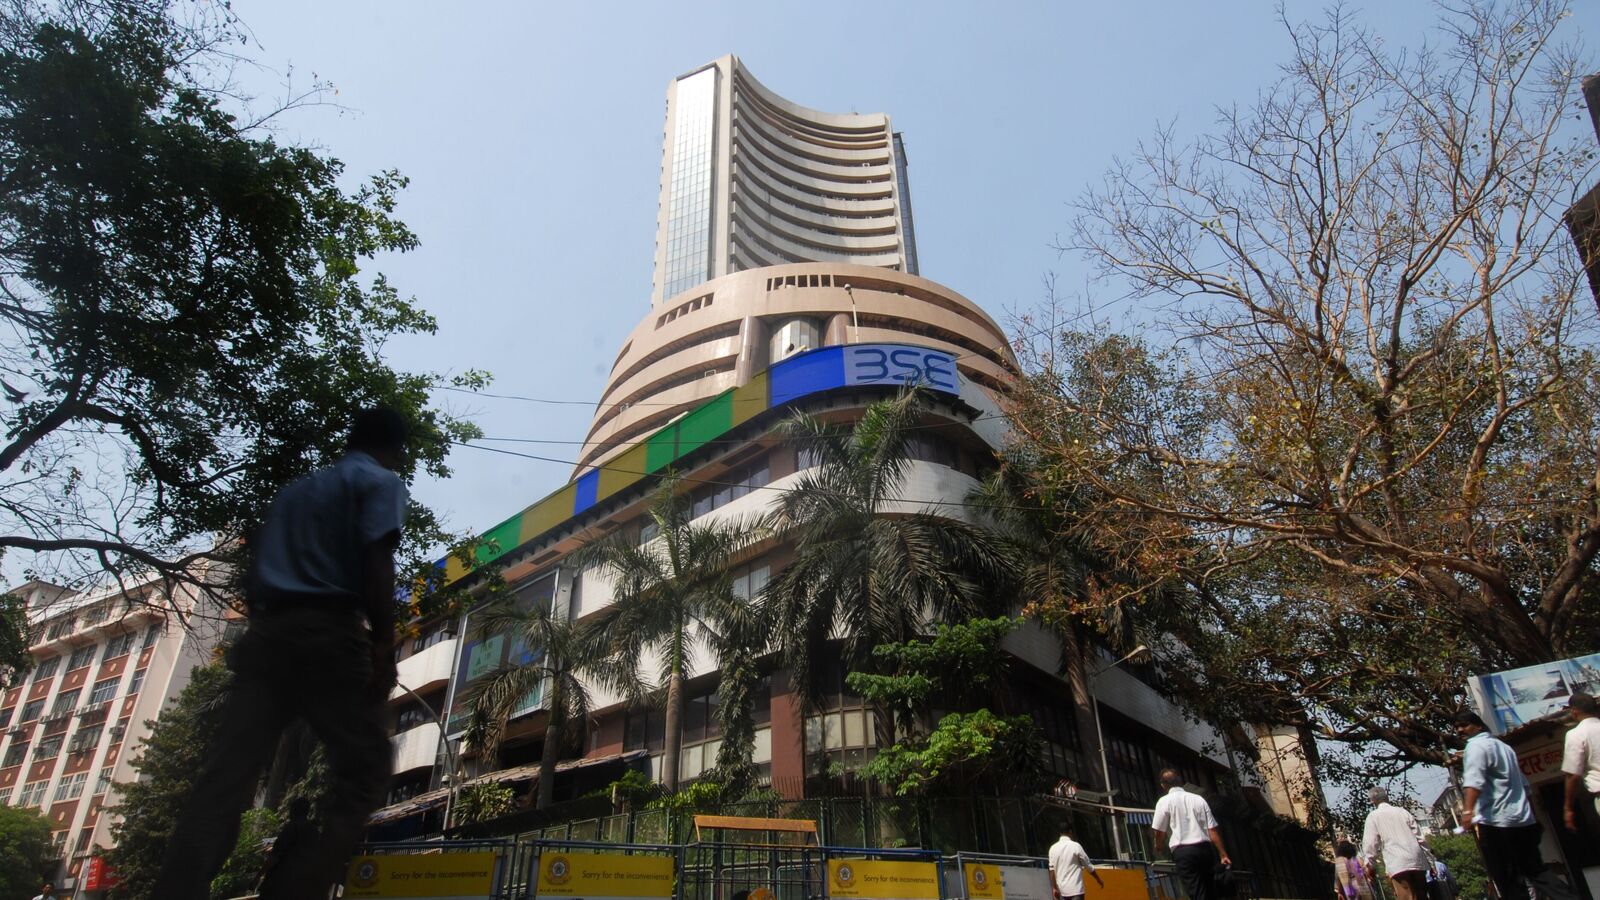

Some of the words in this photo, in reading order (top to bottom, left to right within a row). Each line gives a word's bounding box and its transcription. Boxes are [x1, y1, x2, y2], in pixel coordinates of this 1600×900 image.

[854, 349, 953, 389] BSE
[391, 871, 410, 880] Sorry
[412, 871, 423, 880] for
[425, 871, 436, 879] the
[438, 870, 489, 879] inconvenience
[582, 870, 600, 880] Sorry
[602, 870, 612, 880] for
[614, 871, 625, 879] the
[626, 872, 670, 881] inconvenience
[863, 874, 879, 884] Sorry
[879, 875, 888, 883] for
[889, 875, 899, 883] the
[900, 876, 935, 884] inconvenience
